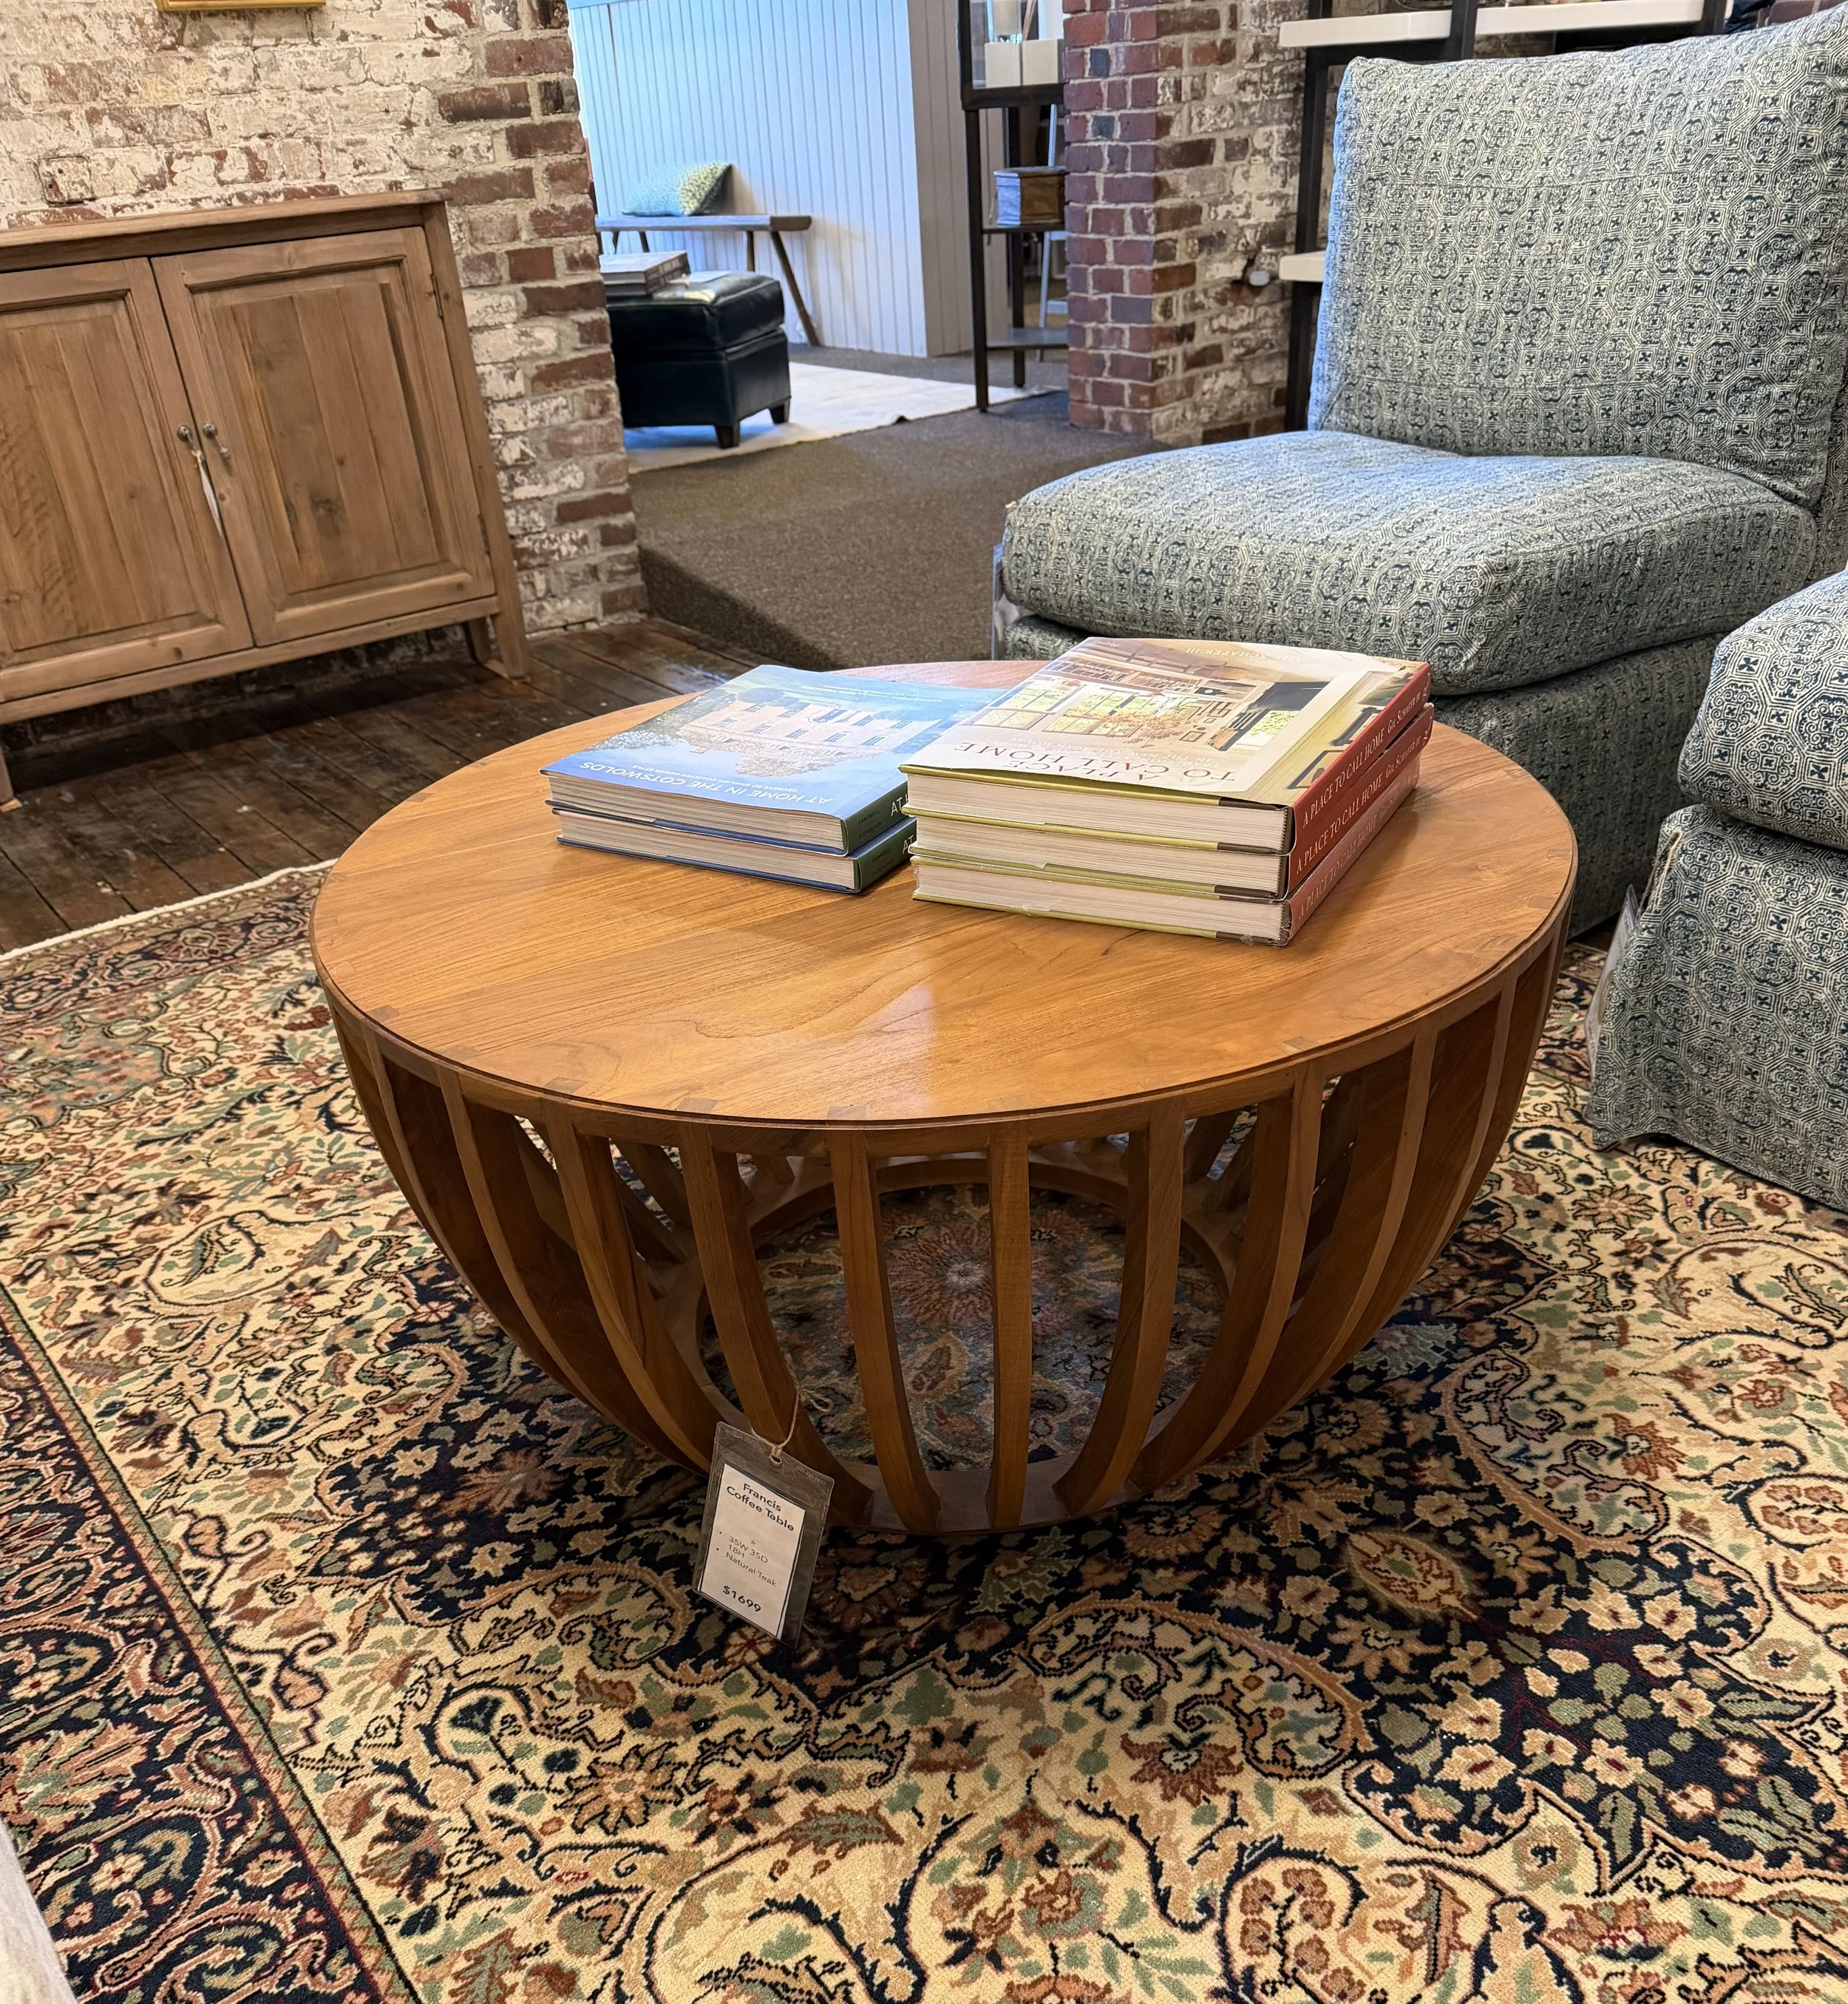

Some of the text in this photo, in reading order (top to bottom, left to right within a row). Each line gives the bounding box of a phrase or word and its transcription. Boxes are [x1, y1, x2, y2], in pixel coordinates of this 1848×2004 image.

[1205, 649, 1267, 660] SCHAFER
[954, 741, 1069, 764] HOME
[579, 761, 686, 786] COTSWOLDS
[1003, 760, 1122, 777] PLACE
[1081, 758, 1169, 774] CALL
[1183, 768, 1235, 781] TO
[687, 781, 722, 792] THE
[1302, 811, 1308, 829] A
[1311, 783, 1334, 821] PLACE
[1335, 771, 1345, 792] TO
[1346, 751, 1363, 780] CALL
[1364, 727, 1385, 761] HOME
[724, 786, 747, 795] IN
[747, 790, 805, 802] HOME
[891, 796, 903, 817] AT
[1296, 857, 1302, 874] A
[1304, 829, 1328, 866] PLACE
[1330, 818, 1341, 838] TO
[1342, 797, 1359, 825] CALL
[1361, 773, 1382, 806] HOME
[902, 835, 914, 855] AT
[1306, 874, 1329, 911] PLACE
[742, 1483, 782, 1512] Francis
[726, 1486, 795, 1532] Coffee Table
[728, 1535, 769, 1564] 35W 35D
[728, 1543, 745, 1560] 18H
[725, 1552, 777, 1588] Natural Teak
[722, 1585, 762, 1613] $1699
